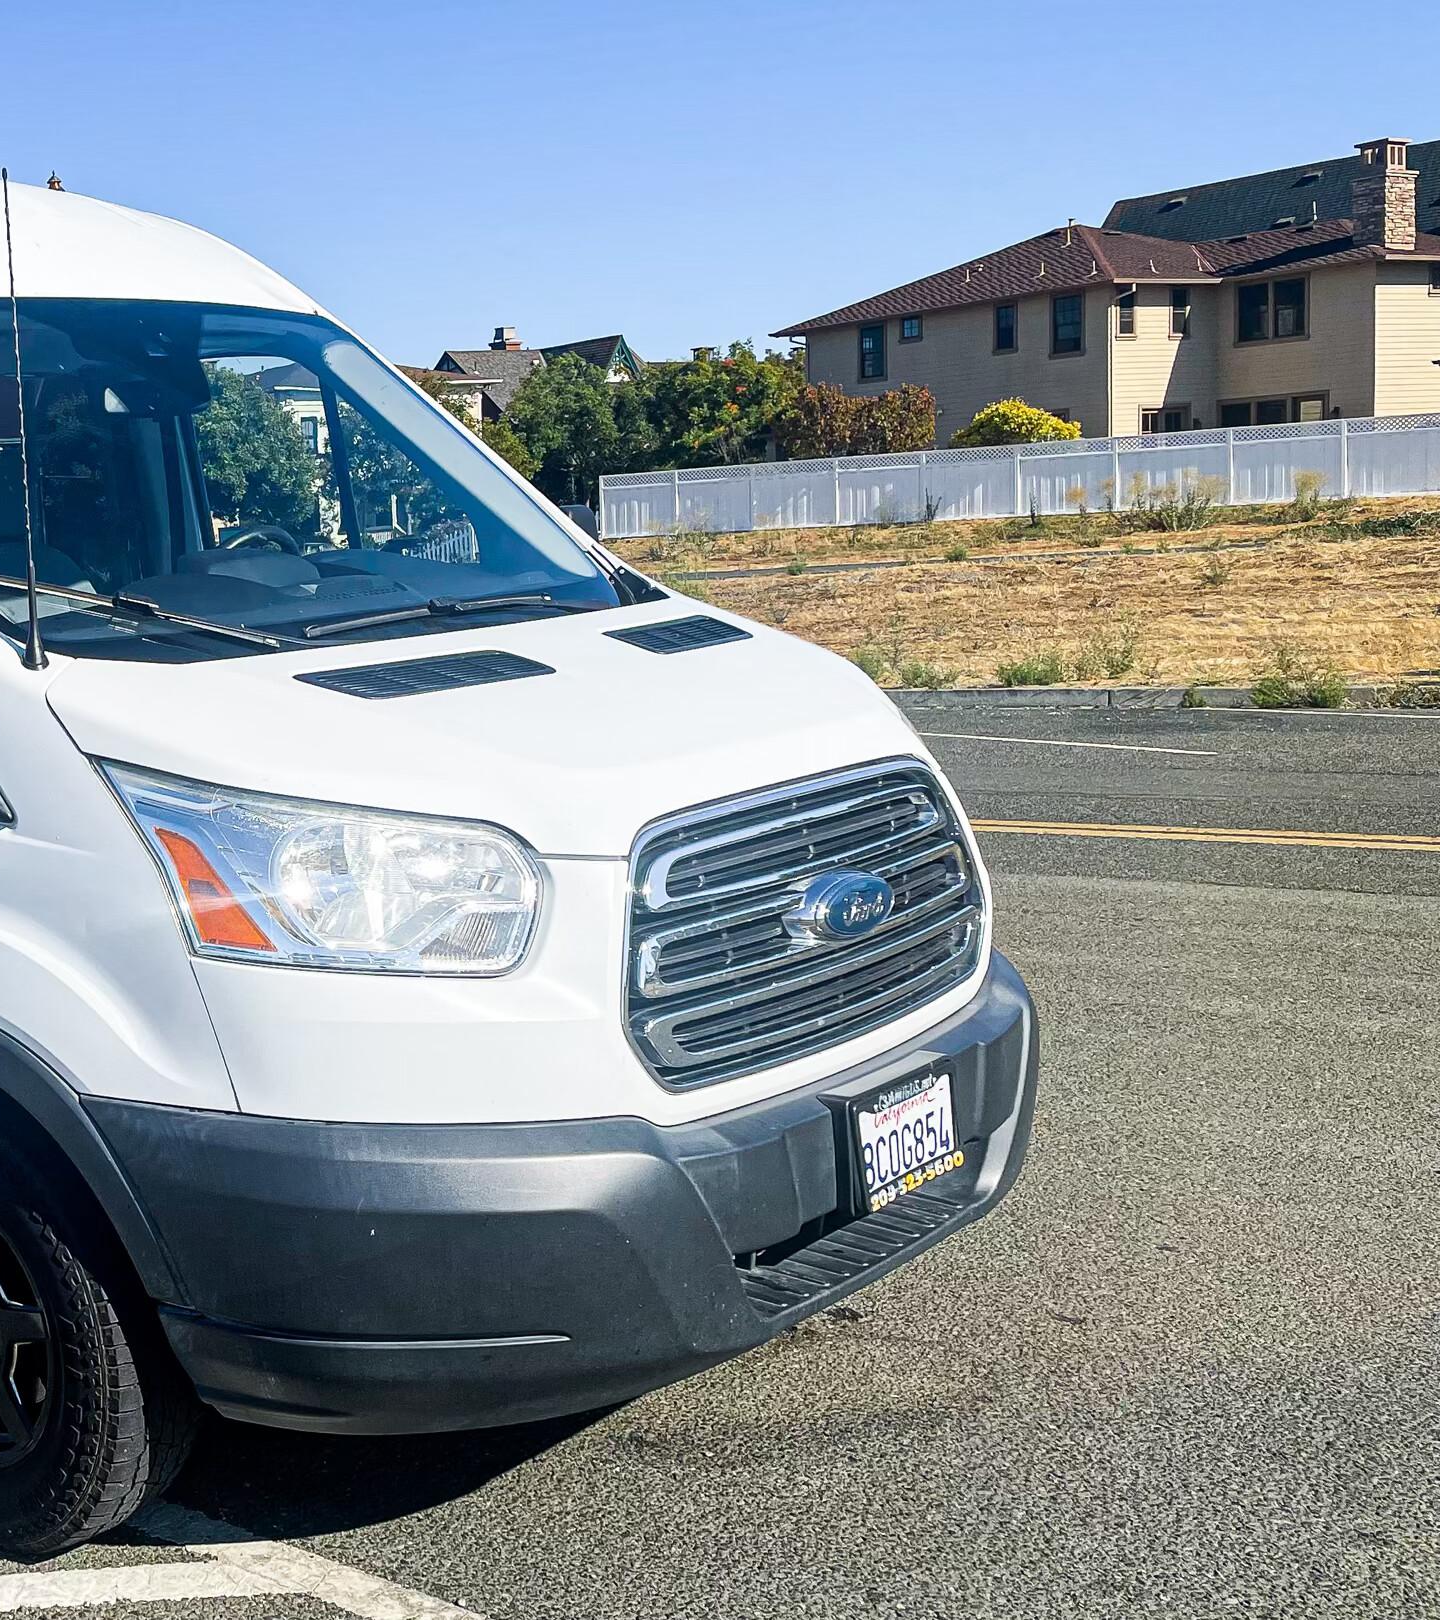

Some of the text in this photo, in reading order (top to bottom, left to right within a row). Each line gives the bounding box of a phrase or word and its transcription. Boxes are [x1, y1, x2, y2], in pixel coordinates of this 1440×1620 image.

[842, 892, 885, 926] Ford
[874, 1091, 936, 1129] California
[863, 1107, 951, 1192] 8COG854
[870, 1150, 965, 1212] 209-523-5600
